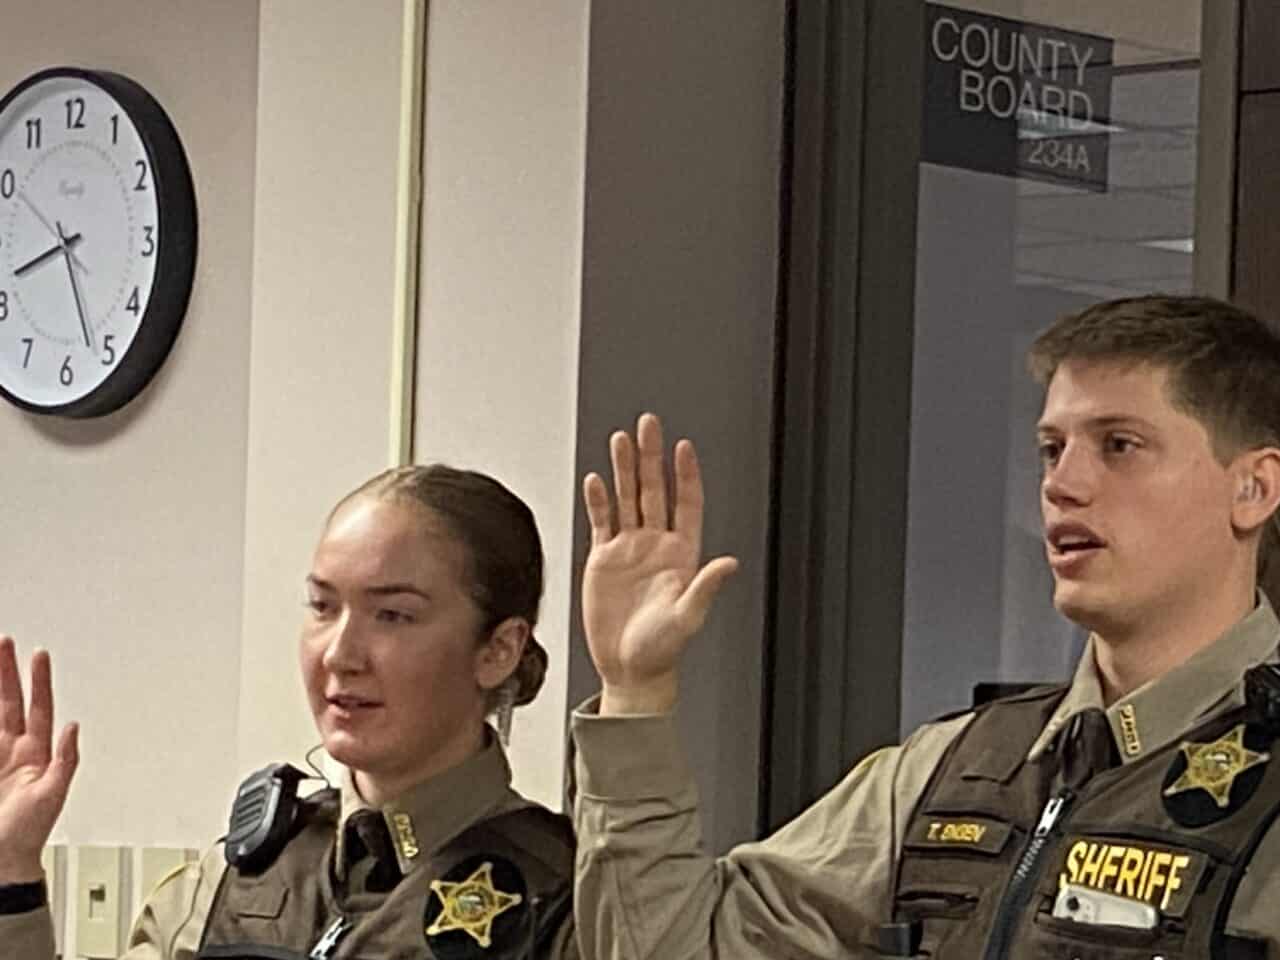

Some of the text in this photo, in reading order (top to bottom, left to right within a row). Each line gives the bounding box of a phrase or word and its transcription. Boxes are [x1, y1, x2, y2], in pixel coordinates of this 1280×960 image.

[932, 18, 1093, 86] COUNTY
[64, 97, 86, 129] 12
[959, 69, 1094, 131] BOARD
[25, 118, 42, 149] 11
[111, 114, 119, 145] 1
[1028, 140, 1091, 173] 234A
[0, 169, 15, 200] 0
[133, 160, 148, 192] 2
[141, 225, 155, 257] 3
[125, 286, 141, 317] 4
[20, 338, 33, 368] 7
[102, 335, 116, 366] 5
[59, 355, 74, 386] 6
[1066, 840, 1190, 911] SHERIFF
